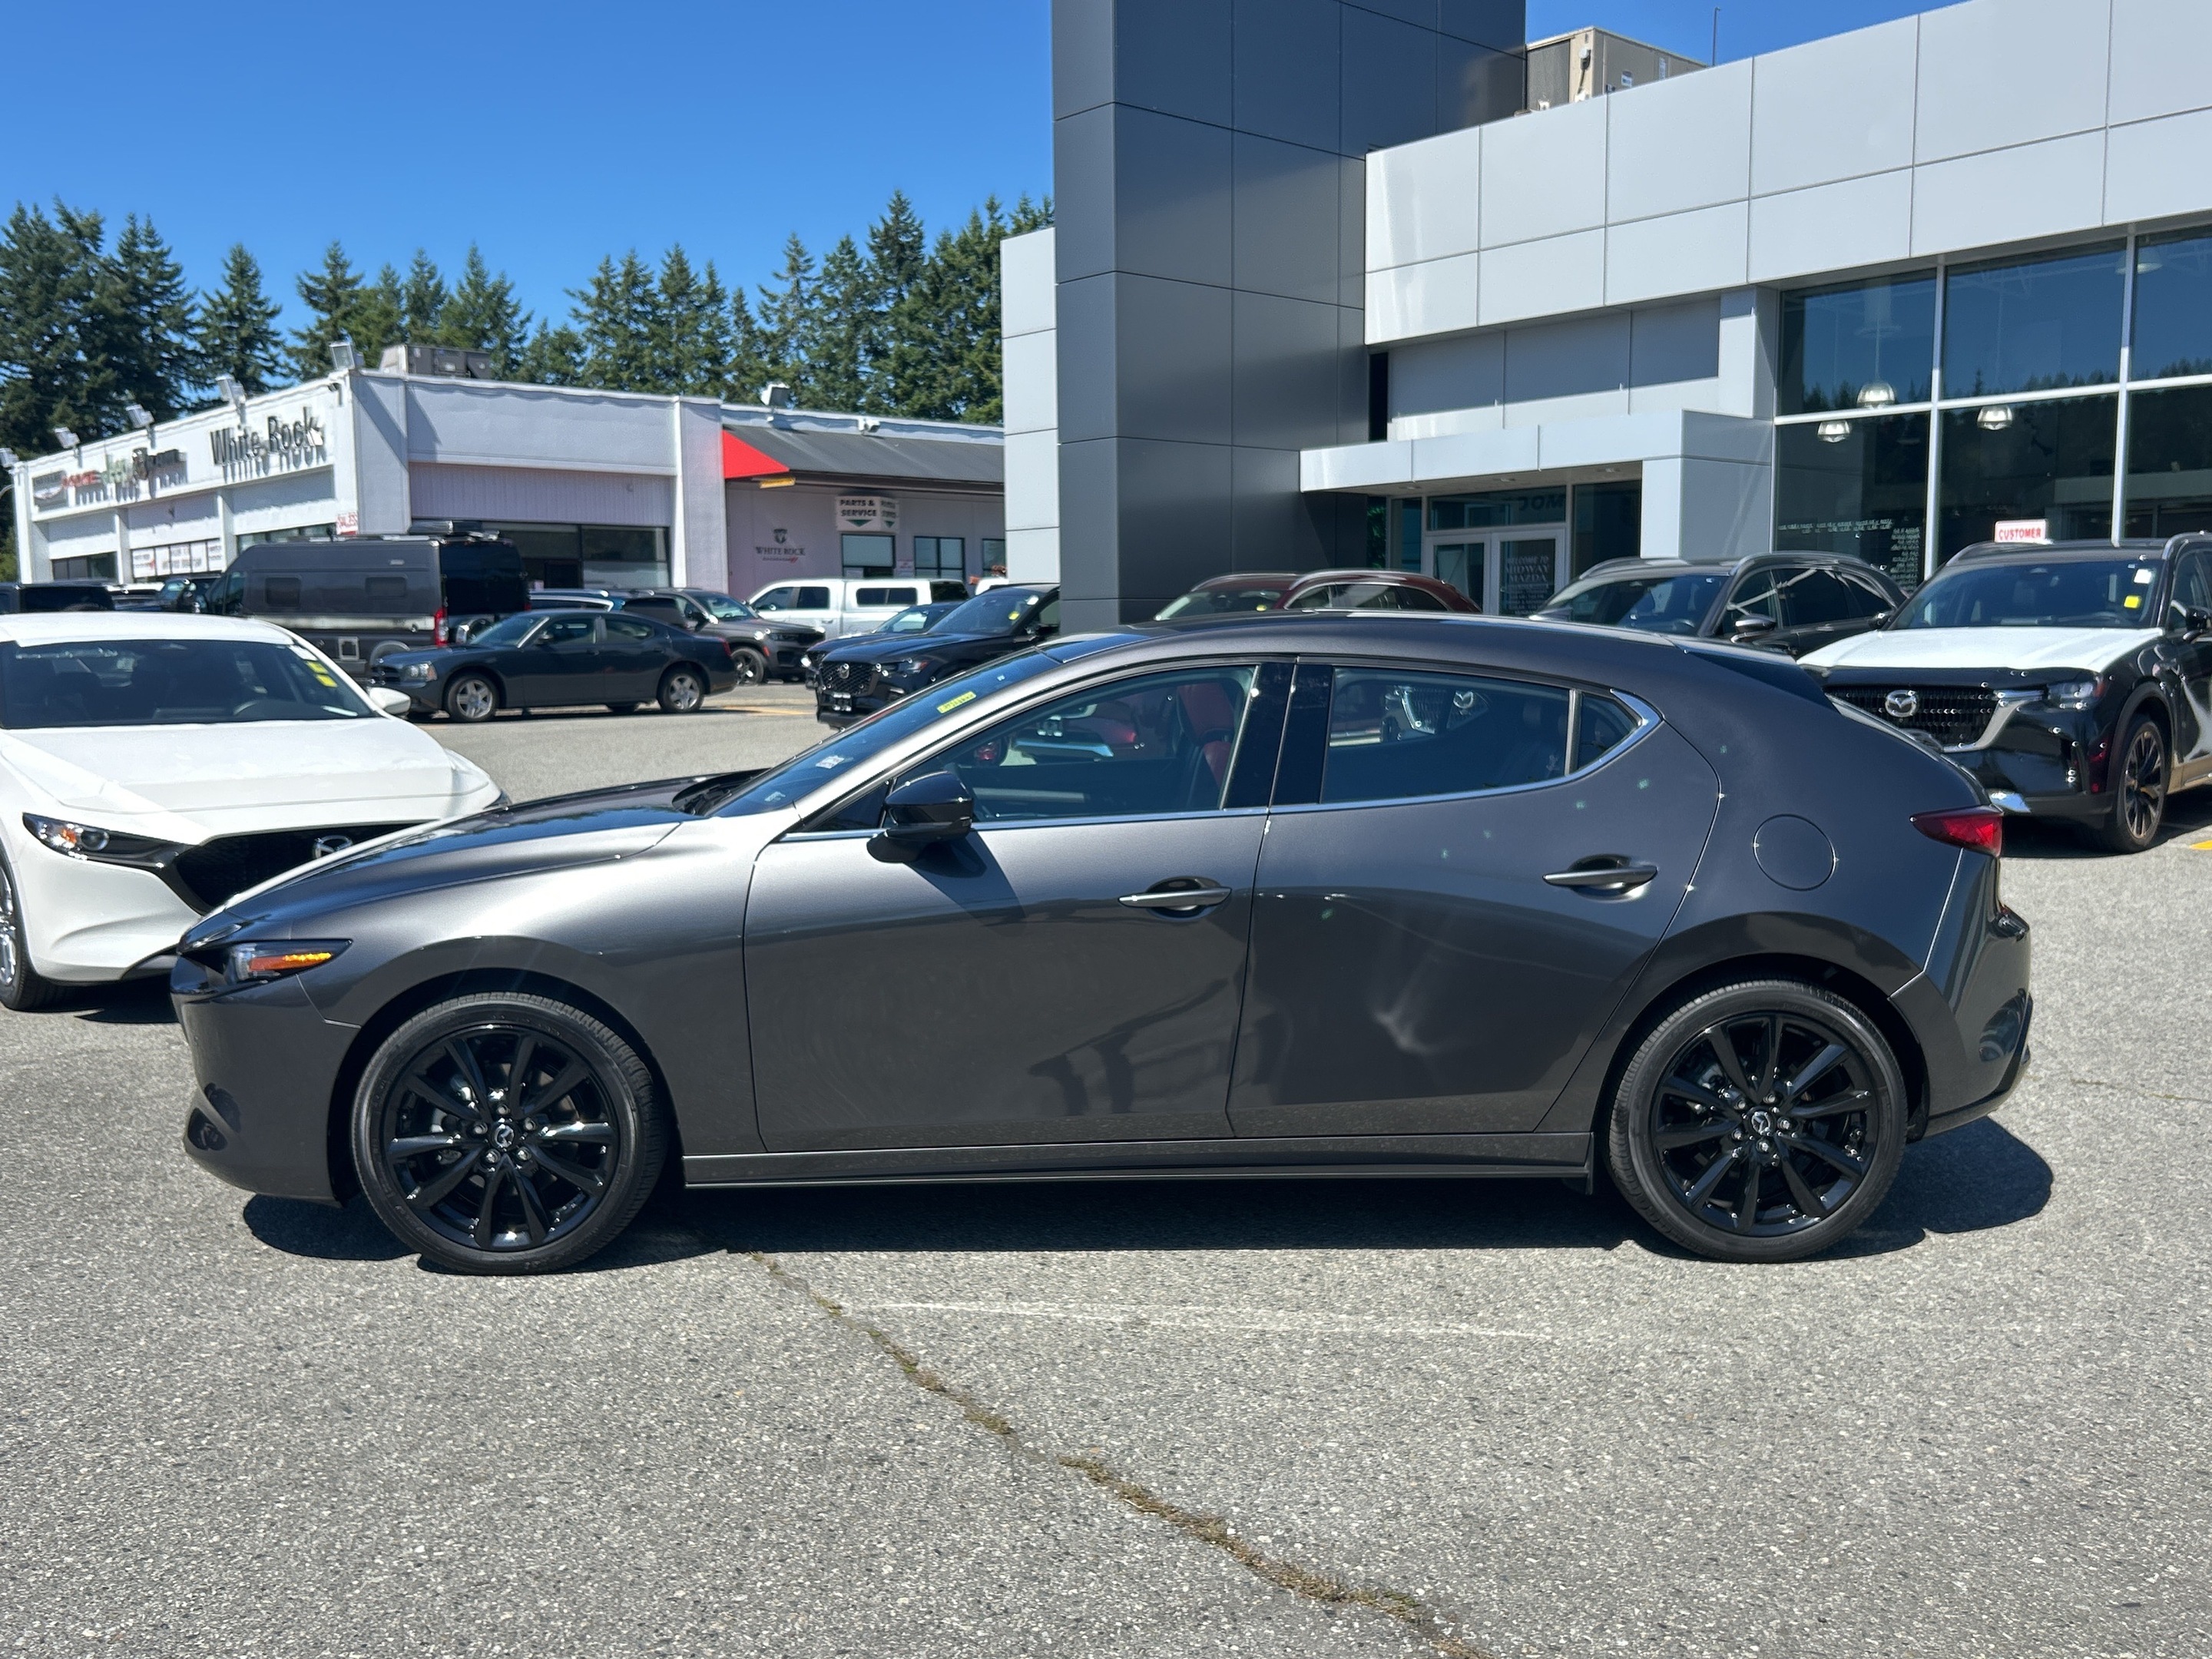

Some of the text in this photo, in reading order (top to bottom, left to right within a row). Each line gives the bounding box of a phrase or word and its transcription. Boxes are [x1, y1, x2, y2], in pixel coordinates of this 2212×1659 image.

[210, 425, 260, 465] White
[268, 406, 324, 452] Rock
[1998, 527, 2041, 541] CUSTOMER
[756, 546, 781, 555] WHITE
[1510, 573, 1548, 582] MAZDA
